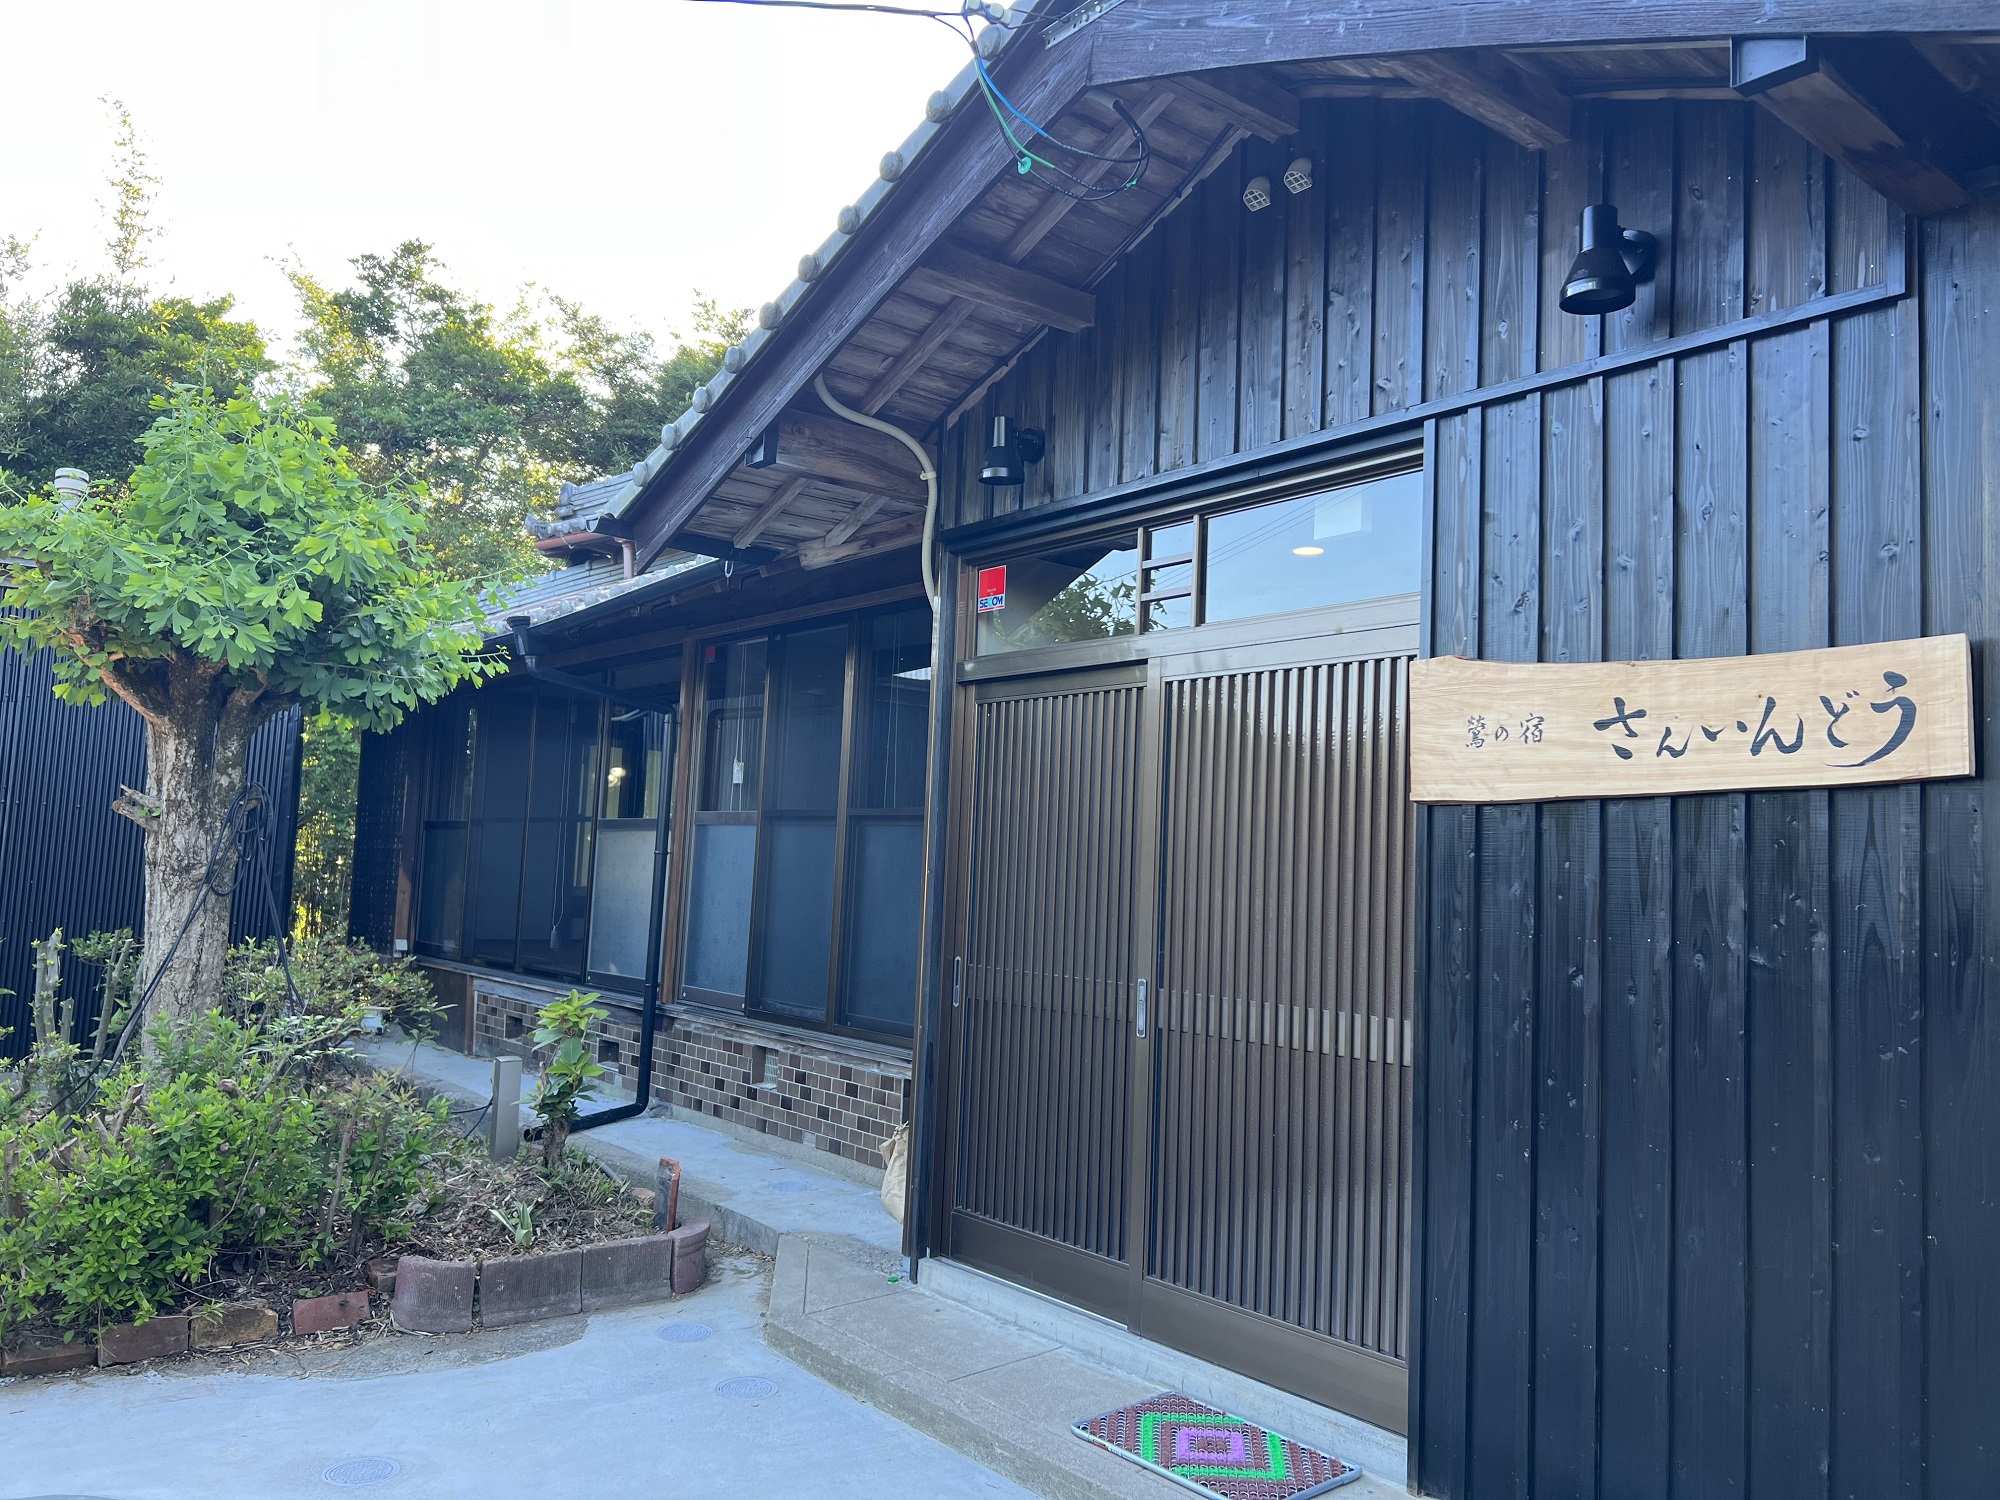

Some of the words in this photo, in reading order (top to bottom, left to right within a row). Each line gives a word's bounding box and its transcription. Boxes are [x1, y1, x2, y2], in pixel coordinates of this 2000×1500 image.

[979, 595, 1003, 608] SECOM
[1594, 671, 1917, 768] さんいんどう
